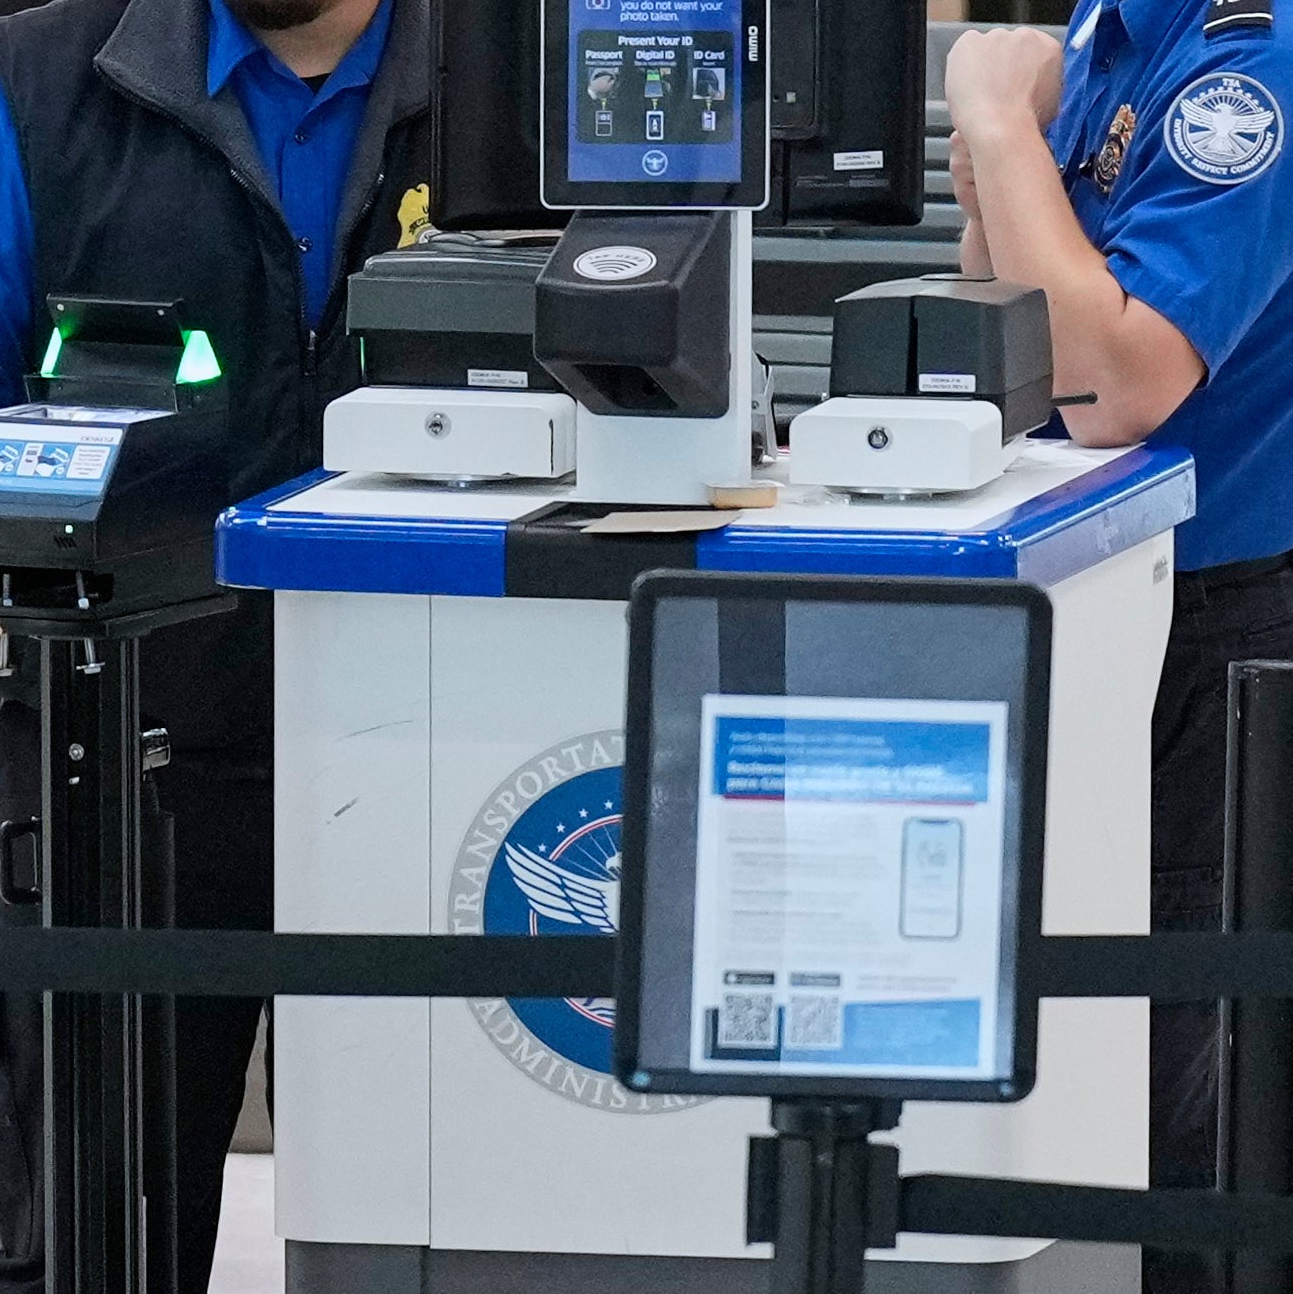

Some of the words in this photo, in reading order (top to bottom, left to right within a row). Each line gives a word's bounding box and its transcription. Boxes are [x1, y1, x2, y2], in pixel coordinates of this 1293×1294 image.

[620, 2, 639, 12] you
[640, 0, 654, 11] do
[655, 1, 672, 11] not
[674, 2, 699, 11] want
[700, 2, 723, 13] your
[620, 11, 649, 23] photo
[650, 11, 679, 22] taken.
[617, 36, 656, 46] Present
[656, 36, 680, 46] Your
[681, 36, 694, 46] ID
[585, 50, 623, 60] Passport
[635, 50, 664, 61] Digital
[665, 50, 676, 60] ID
[693, 50, 703, 60] ID
[704, 50, 725, 60] Card
